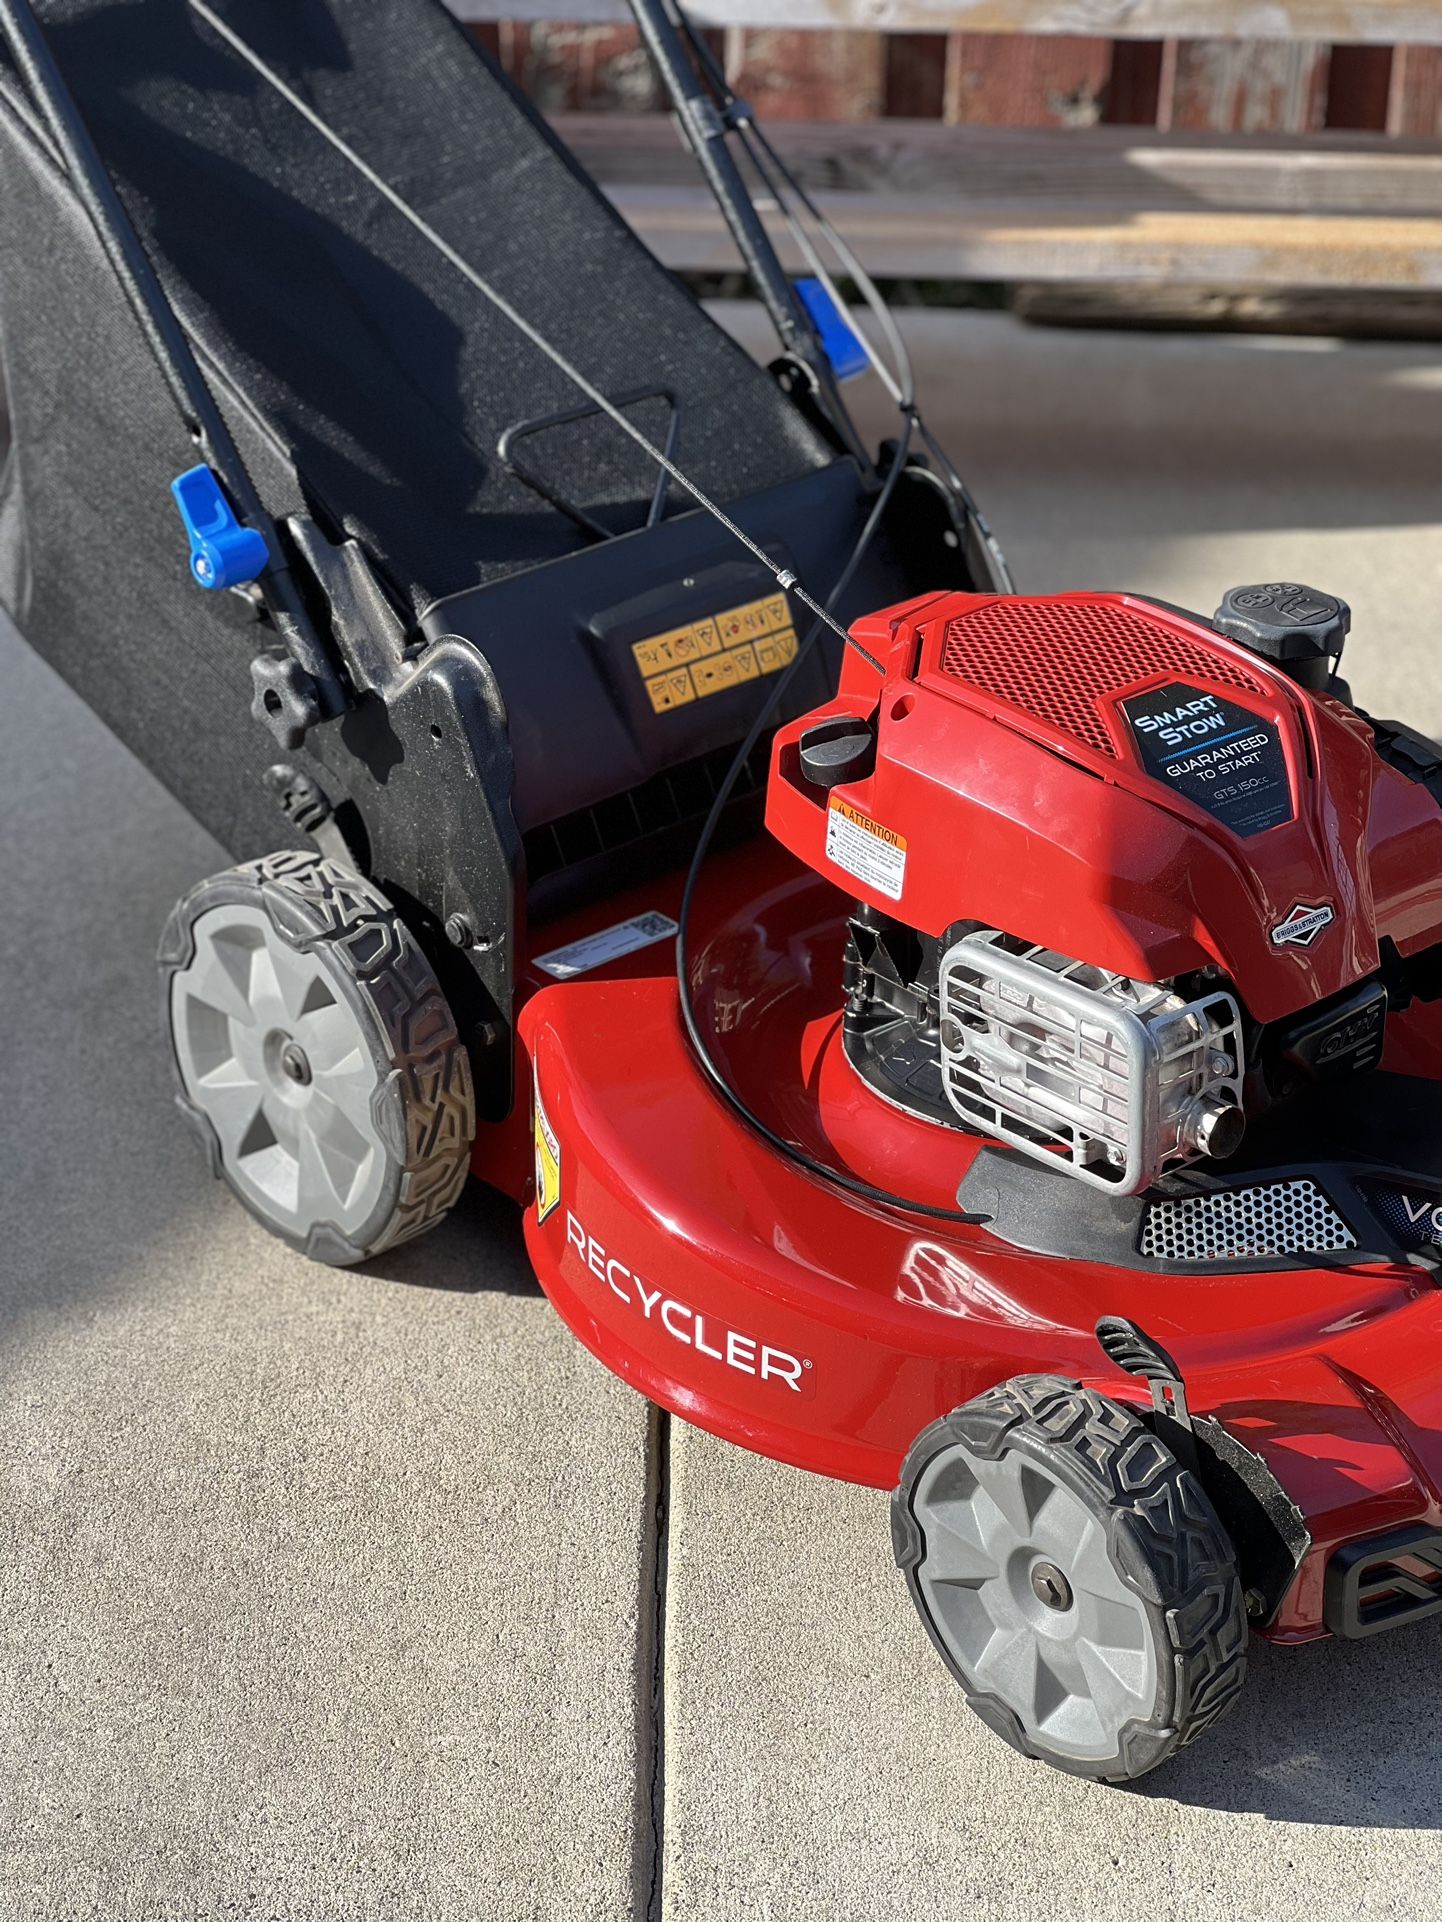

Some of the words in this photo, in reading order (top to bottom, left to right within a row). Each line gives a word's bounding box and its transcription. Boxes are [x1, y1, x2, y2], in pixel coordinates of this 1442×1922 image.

[1134, 695, 1219, 733] SMART
[1166, 733, 1269, 777] GUARANTEED
[1196, 769, 1216, 782] TO
[1213, 785, 1237, 800] GTS
[849, 809, 898, 847] ATTENTION
